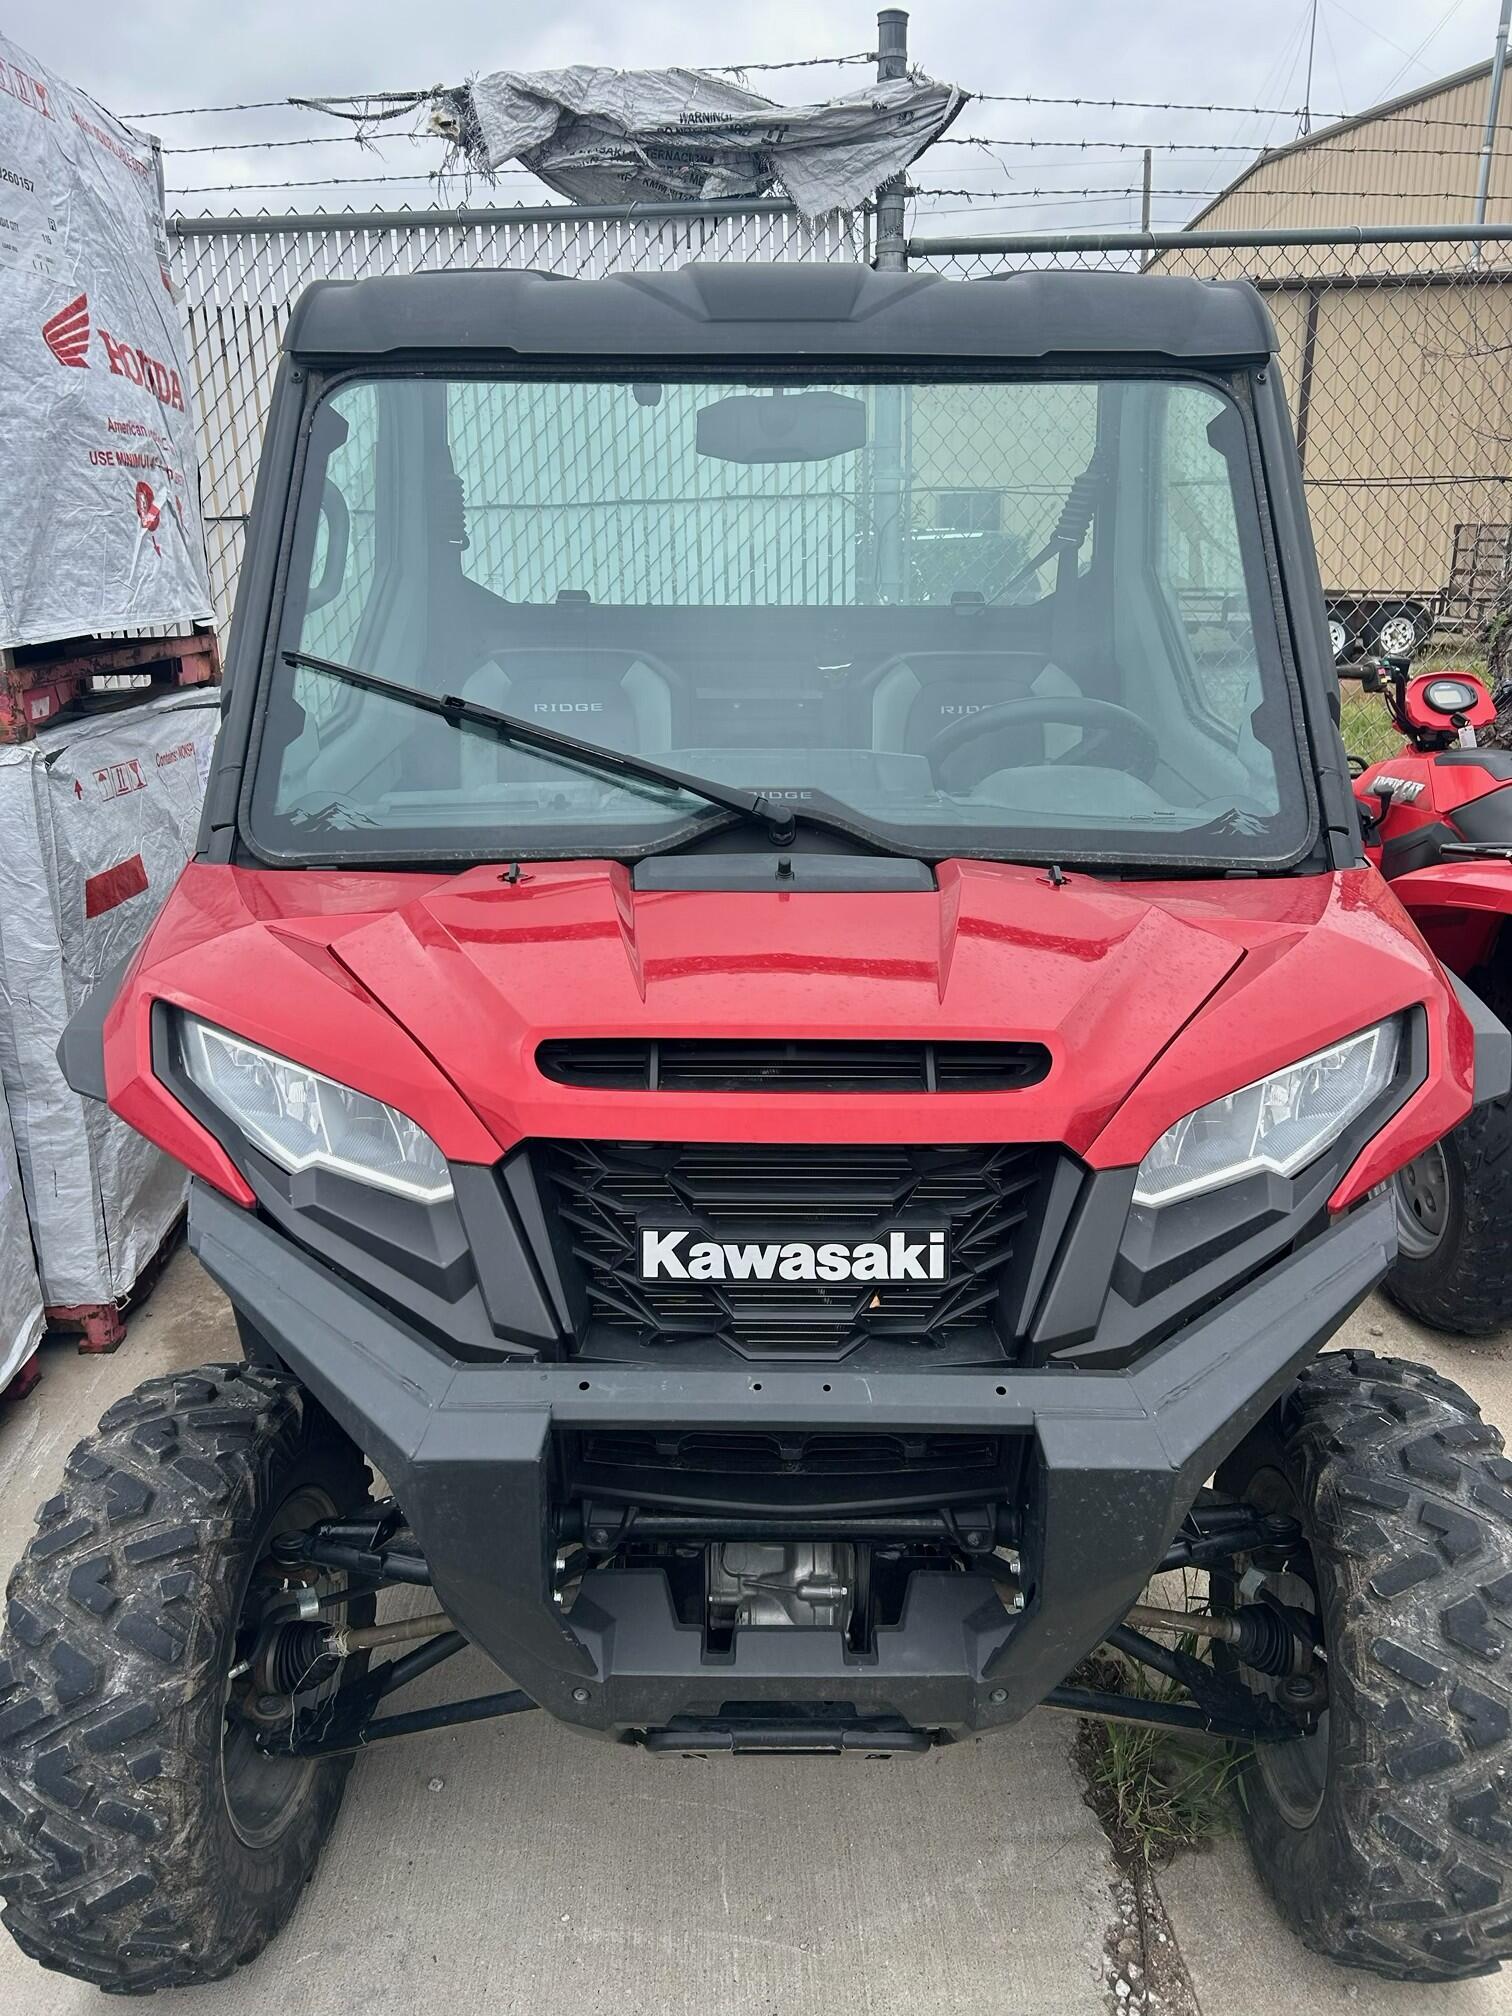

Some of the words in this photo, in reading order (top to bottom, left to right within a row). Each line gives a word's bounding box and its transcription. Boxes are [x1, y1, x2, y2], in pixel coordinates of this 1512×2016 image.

[97, 329, 184, 413] HONDA
[108, 417, 147, 437] American
[89, 451, 114, 466] USE
[534, 703, 603, 712] RIDGE
[941, 705, 988, 714] RID
[641, 1231, 945, 1280] Kawasaki
